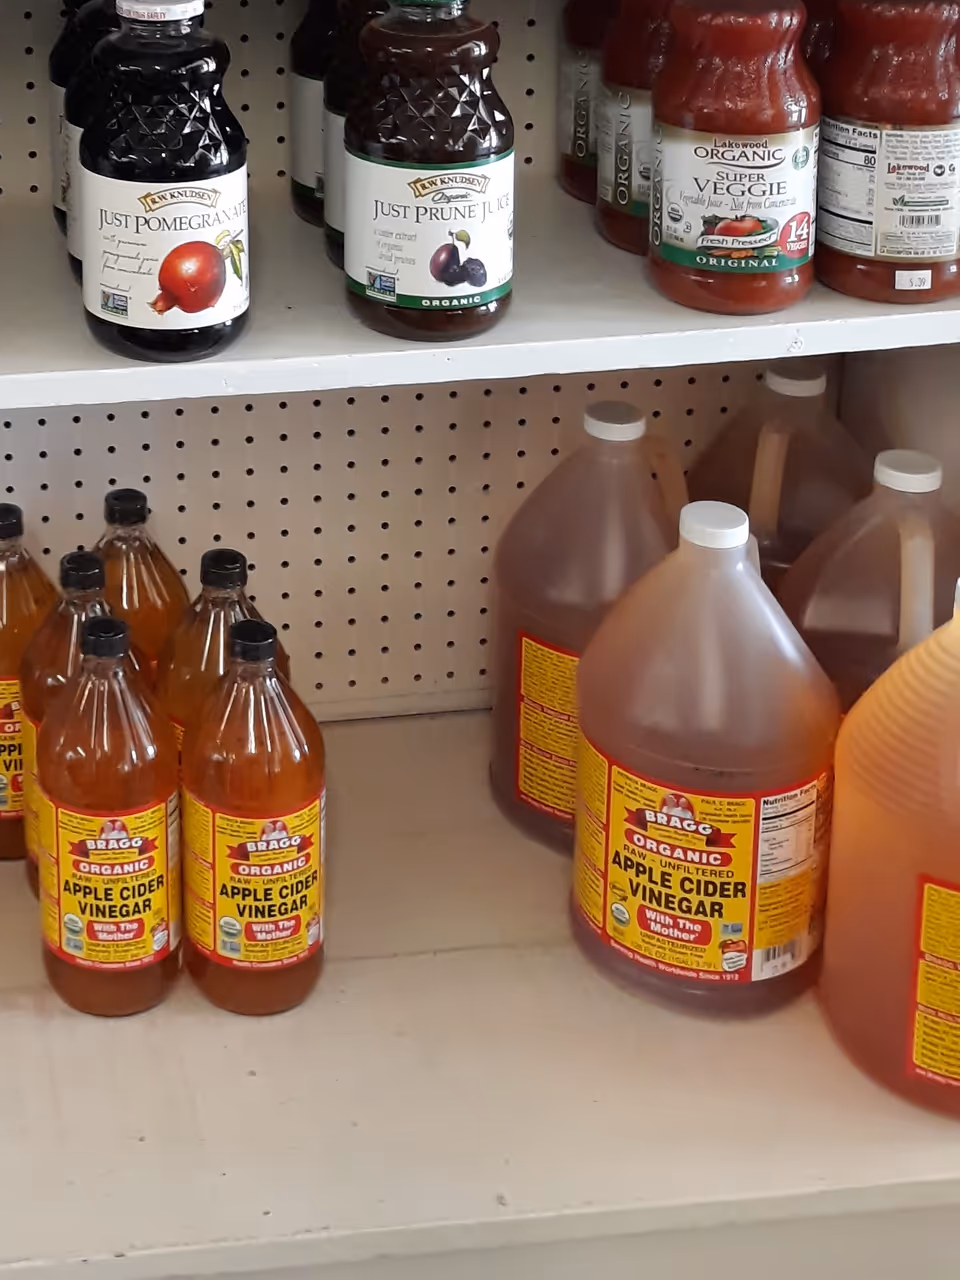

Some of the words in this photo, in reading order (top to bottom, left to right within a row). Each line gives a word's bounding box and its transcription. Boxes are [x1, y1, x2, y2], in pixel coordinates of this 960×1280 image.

[851, 127, 879, 139] Facts
[616, 91, 632, 206] ORGANIC
[713, 137, 769, 149] Lakewood
[693, 146, 786, 162] ORGANIC
[863, 155, 877, 166] 80
[440, 175, 483, 187] KNUDSEN
[715, 170, 767, 183] SUPER
[692, 176, 788, 198] VEGGIE
[169, 190, 213, 202] KNUDSEN
[729, 197, 745, 212] Not
[98, 208, 131, 230] JUST
[373, 200, 410, 221] JUST
[414, 204, 477, 224] PRUNE
[787, 215, 809, 241] 14
[701, 237, 728, 246] Fresh
[731, 232, 777, 247] Pressed
[696, 255, 779, 268] ORIGINAL
[421, 296, 482, 307] ORGANIC
[762, 791, 798, 807] Nutrition
[644, 809, 714, 836] BRAGG
[85, 837, 145, 850] BRAGG
[246, 835, 302, 852] BRAGG
[633, 833, 723, 865] ORGANIC
[79, 859, 150, 875] ORGANIC
[238, 856, 307, 876] ORGANIC
[623, 843, 648, 862] RAW
[659, 859, 735, 879] UNFILTERED
[71, 872, 94, 884] RAW
[101, 868, 158, 886] UNFILTERED
[230, 875, 252, 885] RAW
[611, 849, 673, 890] APPLE
[679, 876, 747, 899] CIDER
[63, 879, 114, 902] APPLE
[119, 874, 165, 901] CIDER
[219, 883, 273, 902] APPLE
[278, 870, 318, 900] CIDER
[236, 894, 309, 919] VINEGAR
[628, 877, 724, 919] VINEGAR
[78, 897, 152, 919] VINEGAR
[251, 922, 276, 932] With
[278, 919, 297, 929] The
[644, 907, 674, 926] With
[677, 917, 702, 932] The
[640, 931, 707, 954] UNPASTEURIZED
[699, 971, 721, 981] Since
